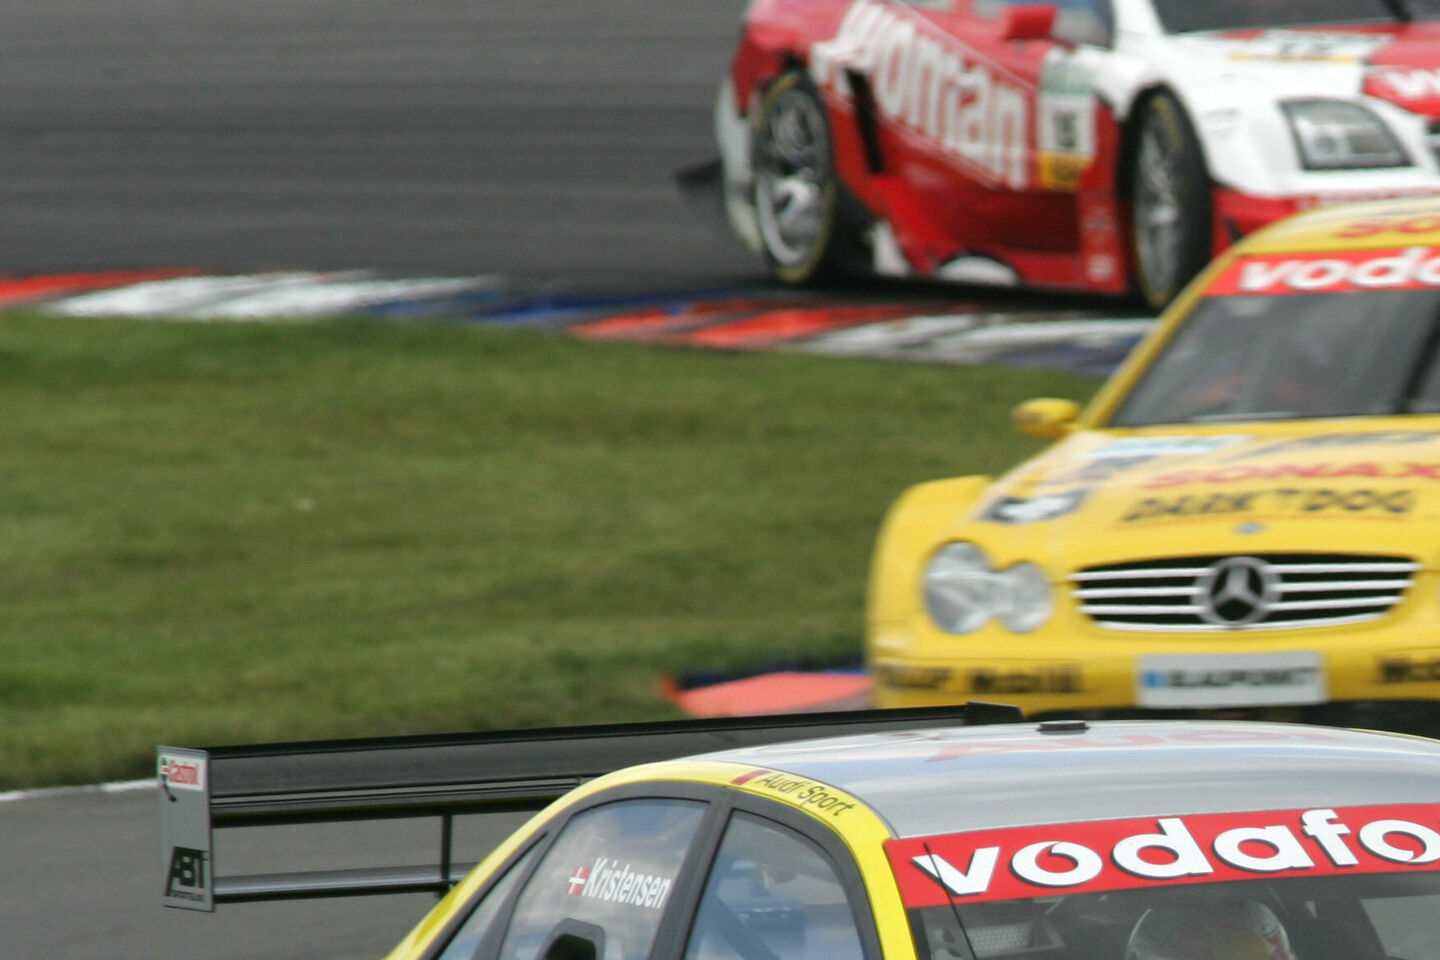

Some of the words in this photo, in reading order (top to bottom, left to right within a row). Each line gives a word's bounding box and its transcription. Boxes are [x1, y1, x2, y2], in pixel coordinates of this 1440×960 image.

[757, 772, 808, 794] Audi
[799, 786, 857, 816] Sport
[164, 846, 208, 896] ABT
[581, 856, 672, 910] Kristensen
